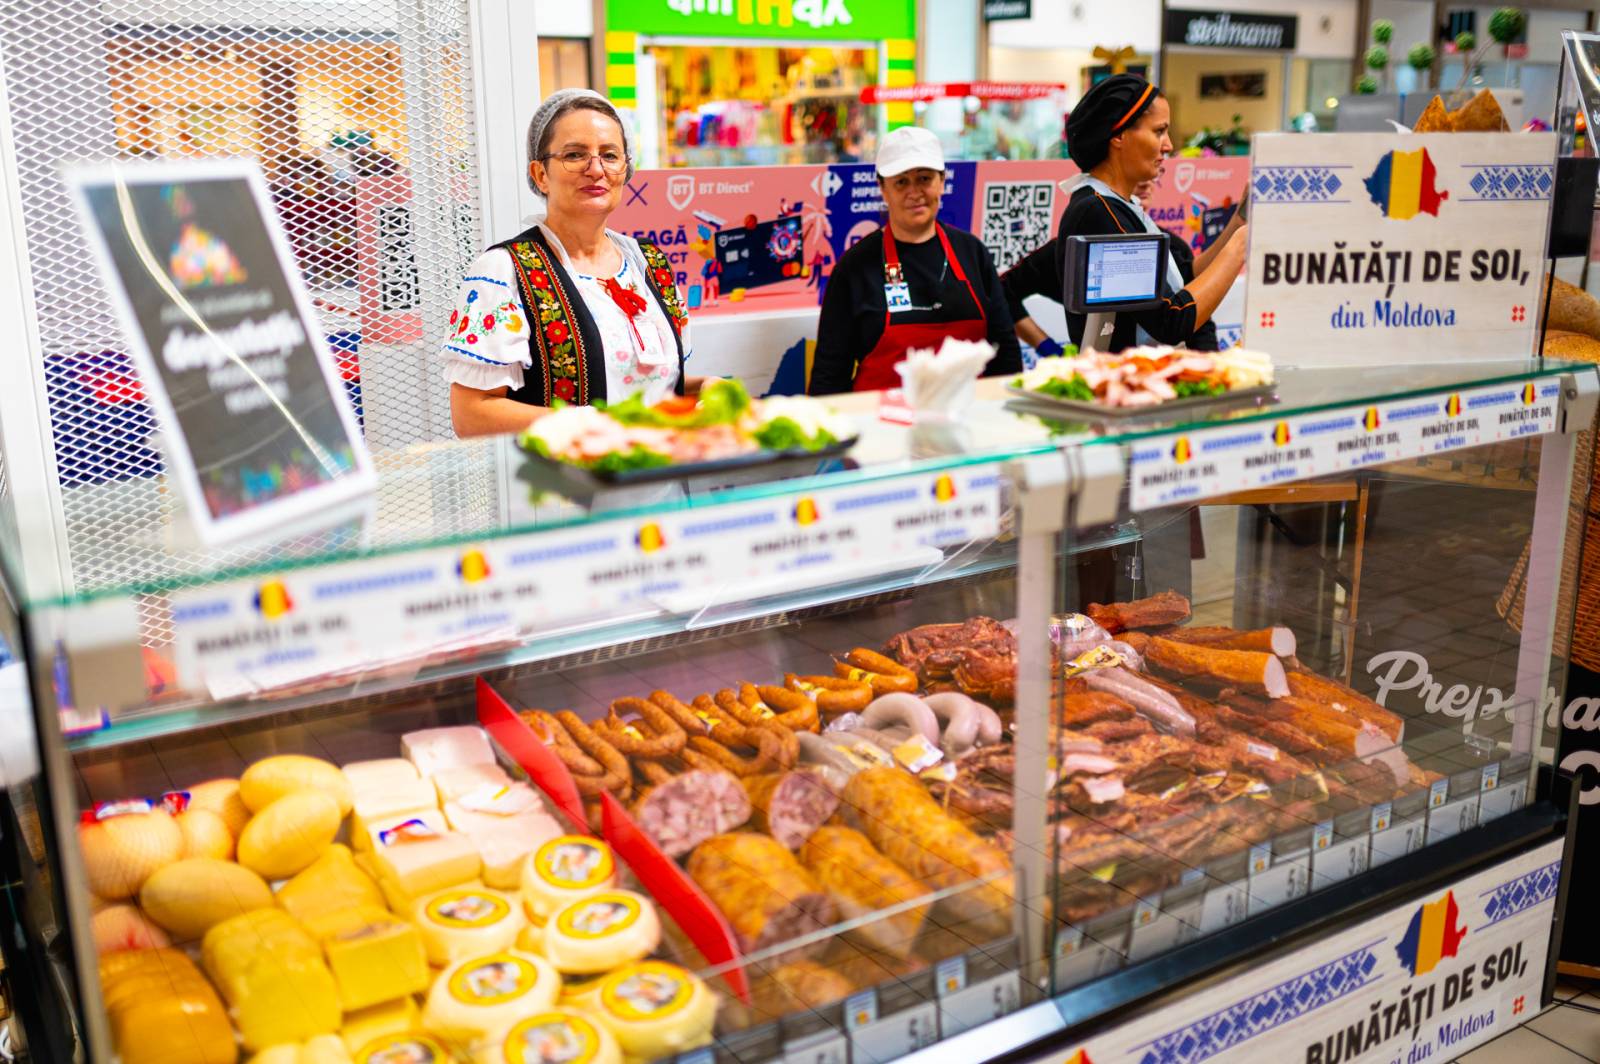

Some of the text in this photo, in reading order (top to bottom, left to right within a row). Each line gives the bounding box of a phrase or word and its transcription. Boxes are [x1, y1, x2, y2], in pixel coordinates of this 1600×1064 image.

[699, 180, 750, 194] BT Direct
[1263, 241, 1529, 298] BUNĂTĂȚI DE SOI,
[1331, 300, 1456, 328] din Moldova
[1442, 964, 1476, 1011] DE
[1481, 941, 1529, 990] SOI,
[1437, 1009, 1495, 1051] Moldova
